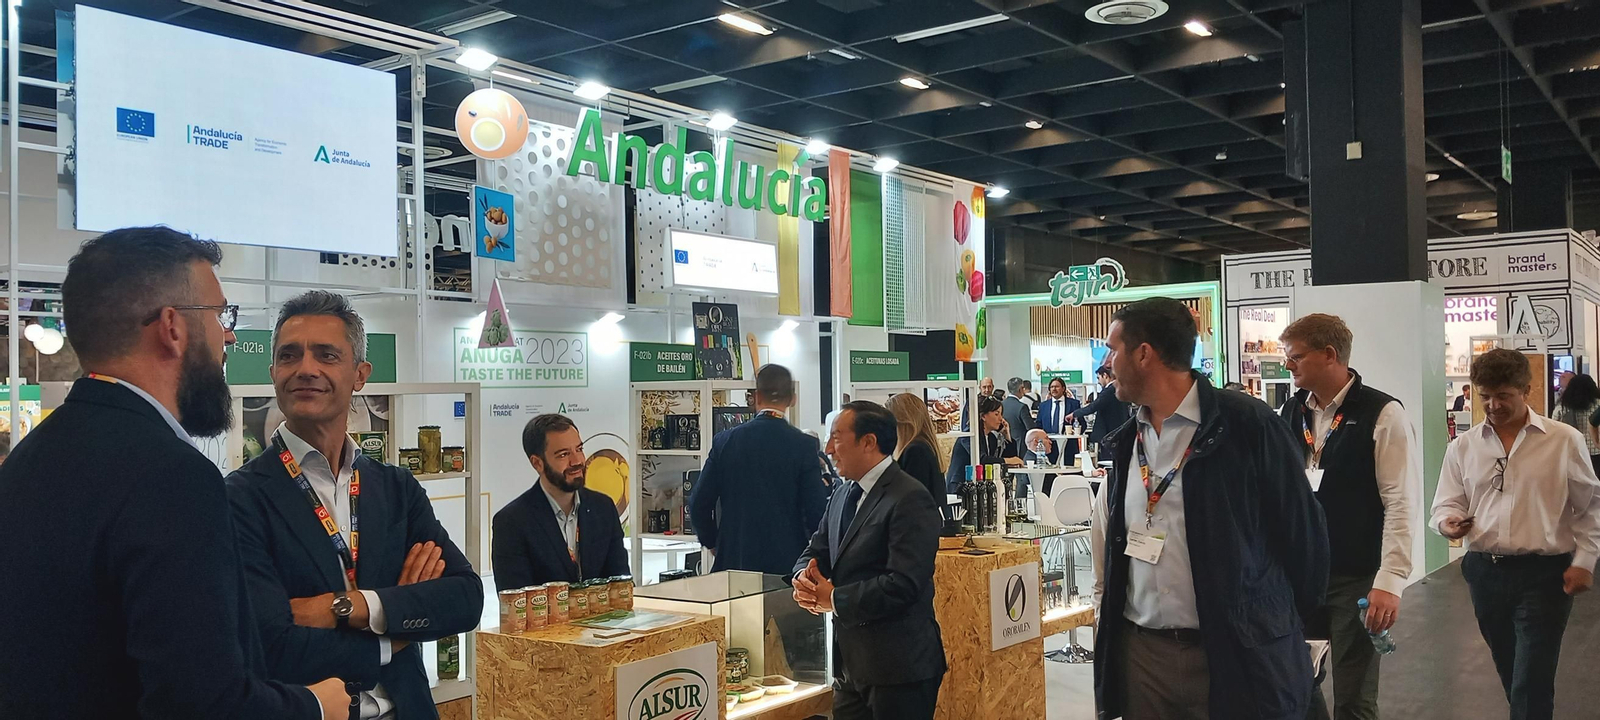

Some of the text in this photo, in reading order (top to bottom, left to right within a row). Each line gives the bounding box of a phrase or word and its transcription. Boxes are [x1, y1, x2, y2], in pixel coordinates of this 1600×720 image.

[192, 126, 243, 142] Andalucía
[192, 136, 228, 150] TRADE
[332, 149, 350, 158] Junta
[340, 158, 371, 168] Andalucía
[566, 106, 828, 223] Andalucía
[1508, 252, 1546, 264] brand
[1427, 256, 1488, 279] TORE
[1508, 262, 1557, 274] masters
[1250, 270, 1295, 290] THE
[1264, 310, 1276, 322] Deal
[1444, 308, 1497, 322] maste
[233, 342, 264, 354] F-021a
[460, 338, 584, 364] ANUGA 2023
[634, 350, 693, 361] F-021b ACEITES ORO
[460, 368, 584, 380] TASTE THE FUTURE
[657, 363, 686, 374] DE BAILÉN
[639, 684, 702, 720] ALSUR
